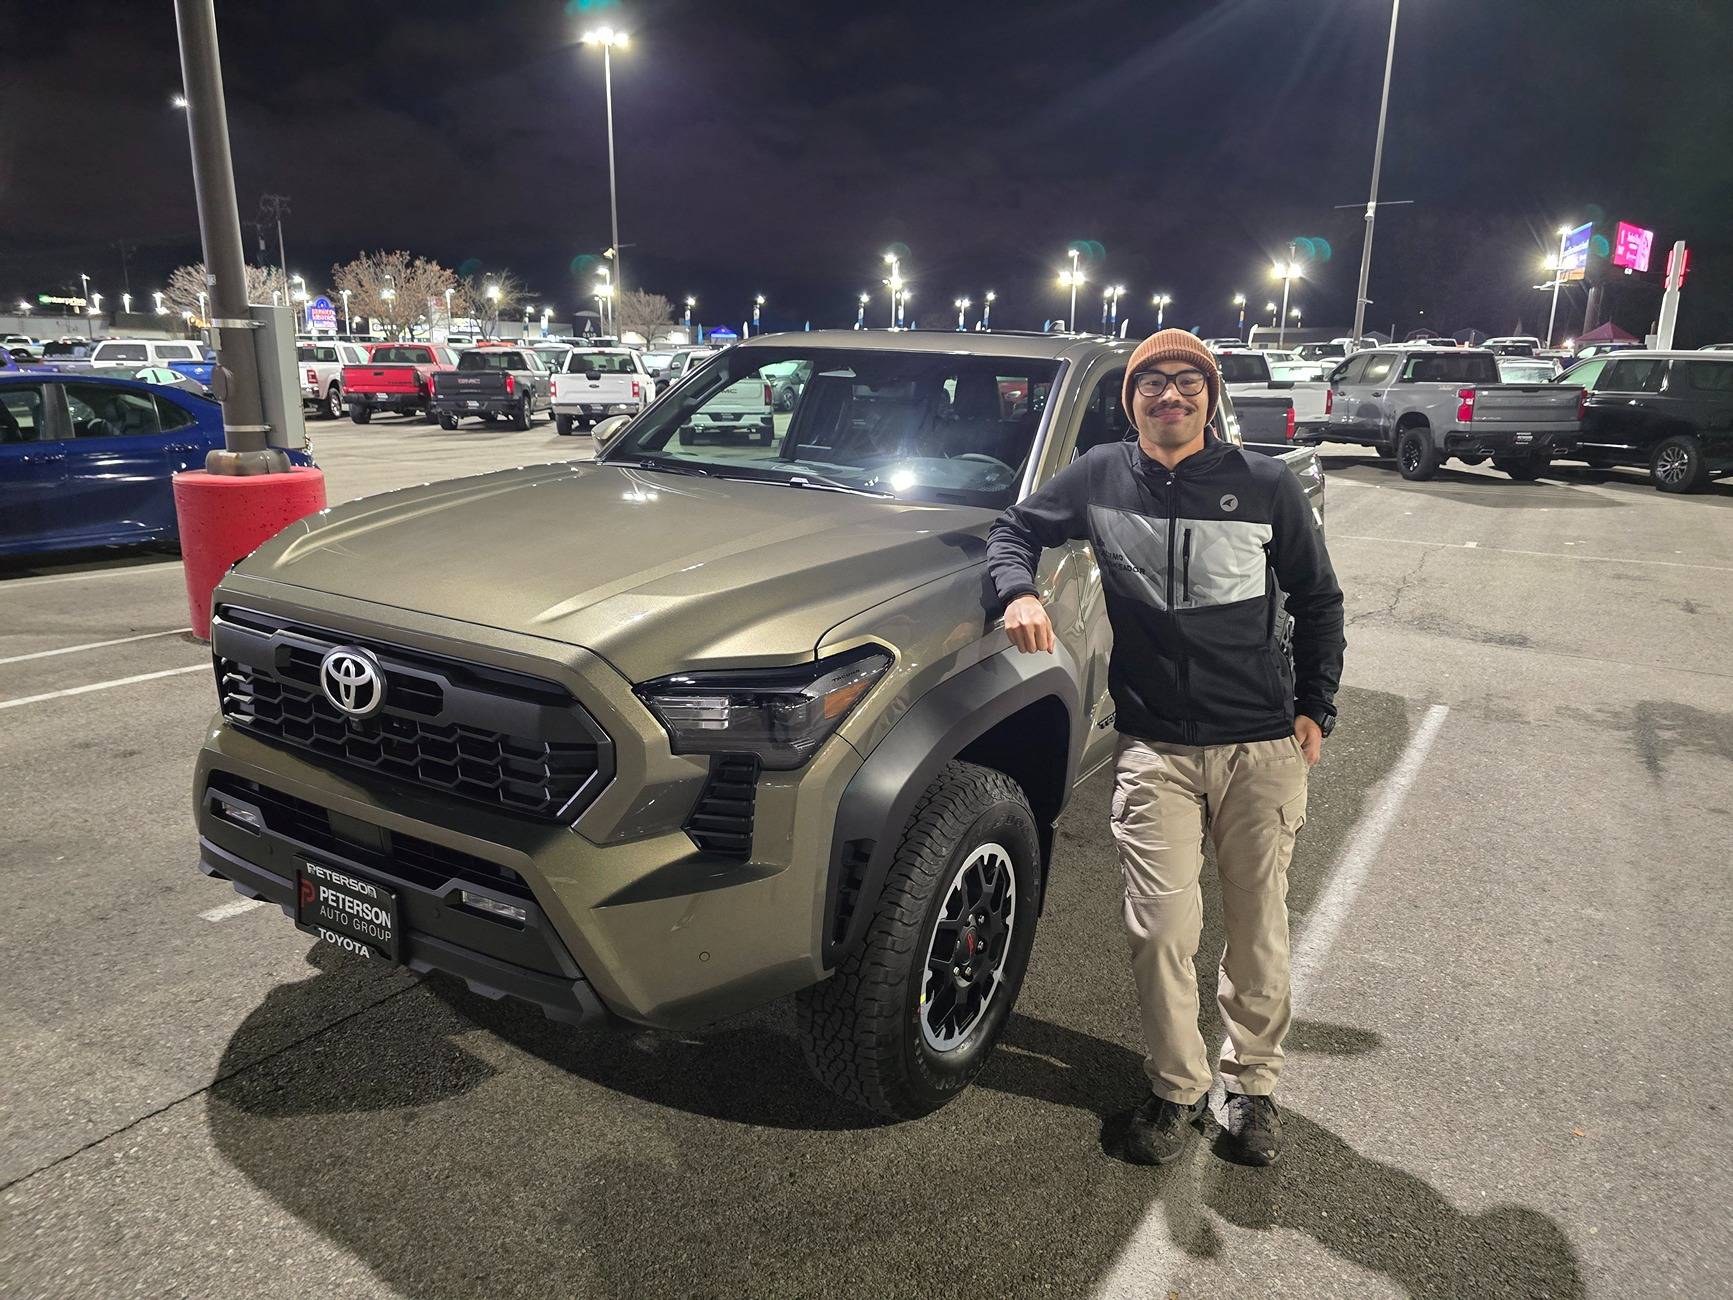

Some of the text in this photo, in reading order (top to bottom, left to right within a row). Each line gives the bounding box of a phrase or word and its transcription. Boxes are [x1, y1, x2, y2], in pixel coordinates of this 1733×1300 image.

[306, 862, 377, 899] PETERSON
[319, 885, 391, 929] PETERSON
[320, 905, 392, 942] AUTO GROUP
[318, 926, 370, 959] TOYOTA
